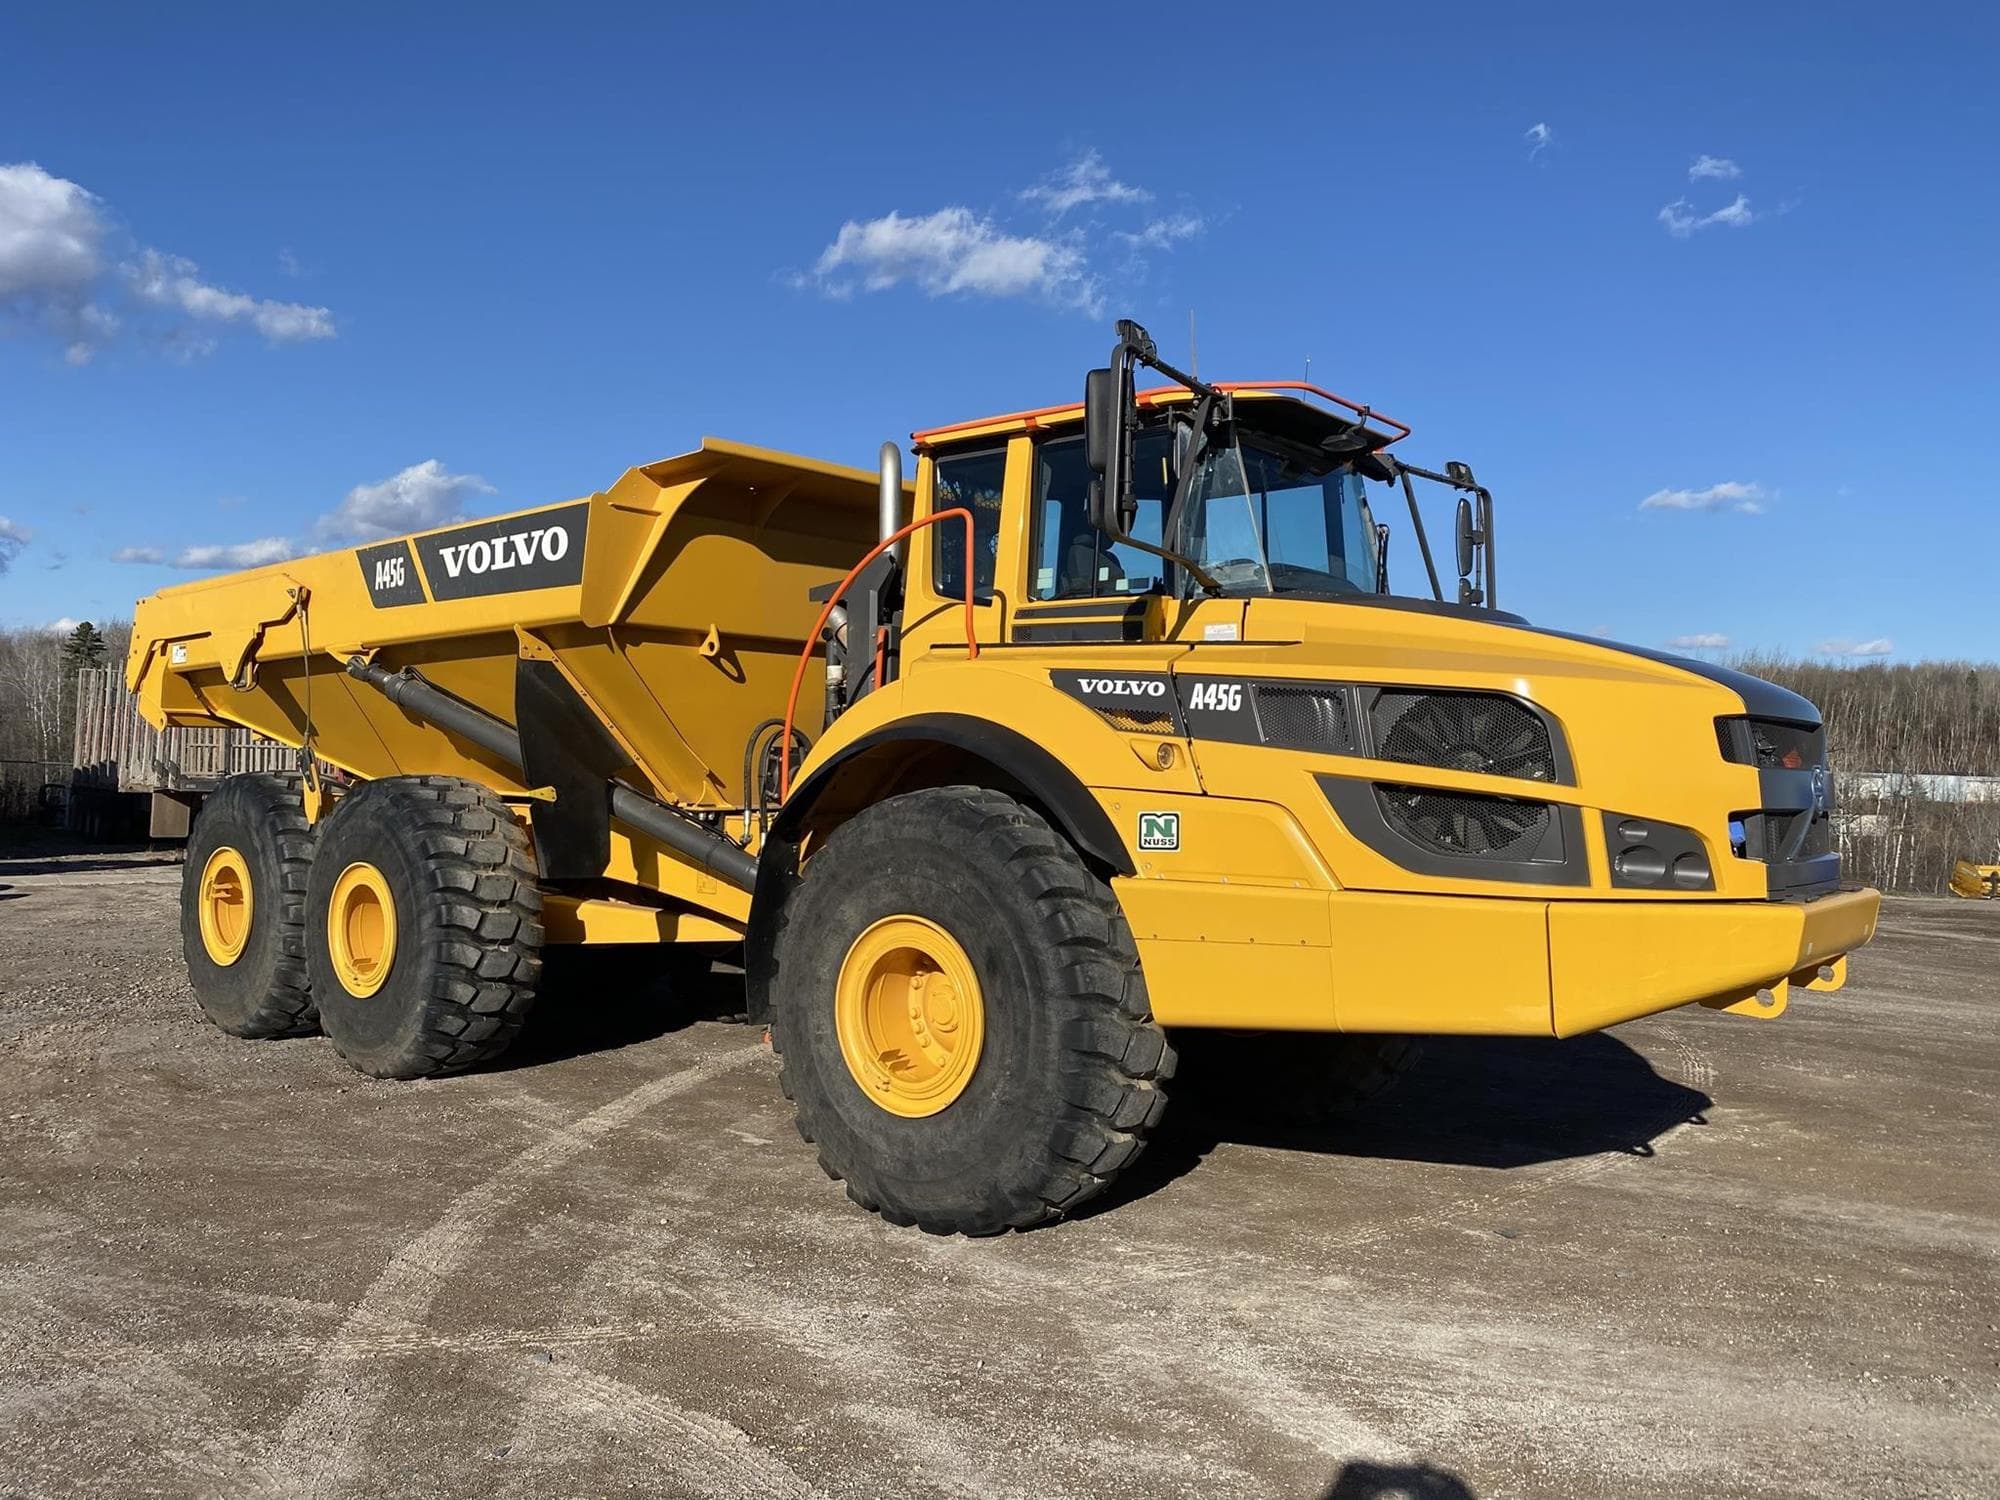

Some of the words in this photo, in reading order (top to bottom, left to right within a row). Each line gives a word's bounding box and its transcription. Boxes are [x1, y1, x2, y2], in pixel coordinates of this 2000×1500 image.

[439, 526, 569, 578] VOLVO
[375, 557, 405, 590] A45G
[1077, 678, 1166, 697] VOLVO
[1189, 683, 1242, 711] A45G
[1143, 818, 1175, 838] N
[1143, 838, 1175, 846] NUSS
